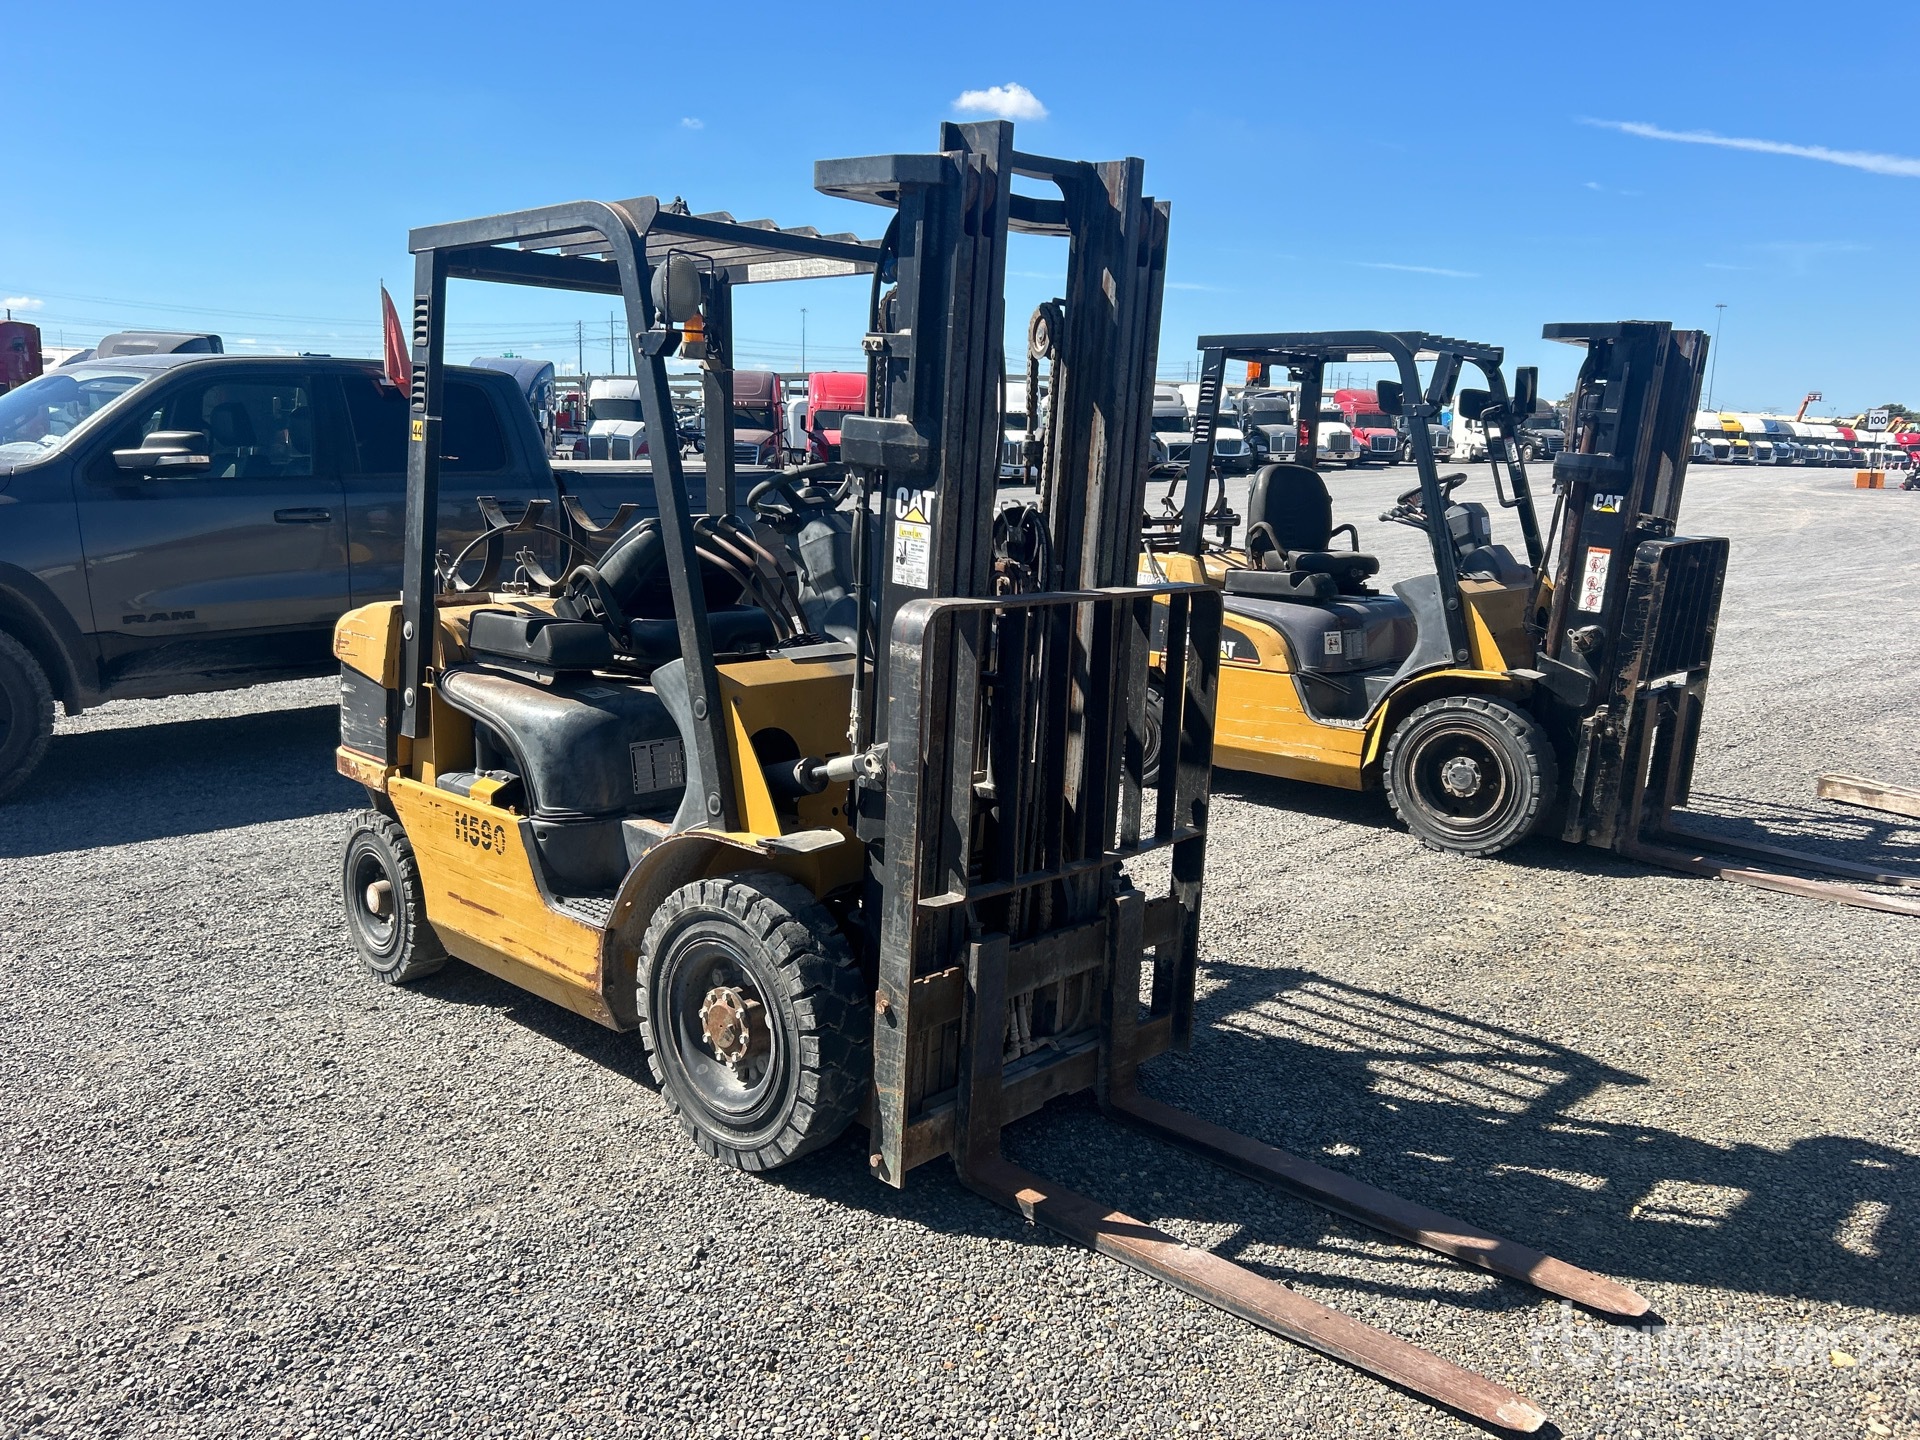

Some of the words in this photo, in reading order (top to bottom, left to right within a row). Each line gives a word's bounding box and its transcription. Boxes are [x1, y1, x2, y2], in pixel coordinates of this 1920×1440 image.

[1870, 416, 1887, 425] 100
[412, 424, 422, 438] 44
[895, 486, 936, 523] CAT
[1592, 493, 1624, 514] CAT
[122, 610, 196, 625] RAM
[1220, 640, 1238, 659] AT
